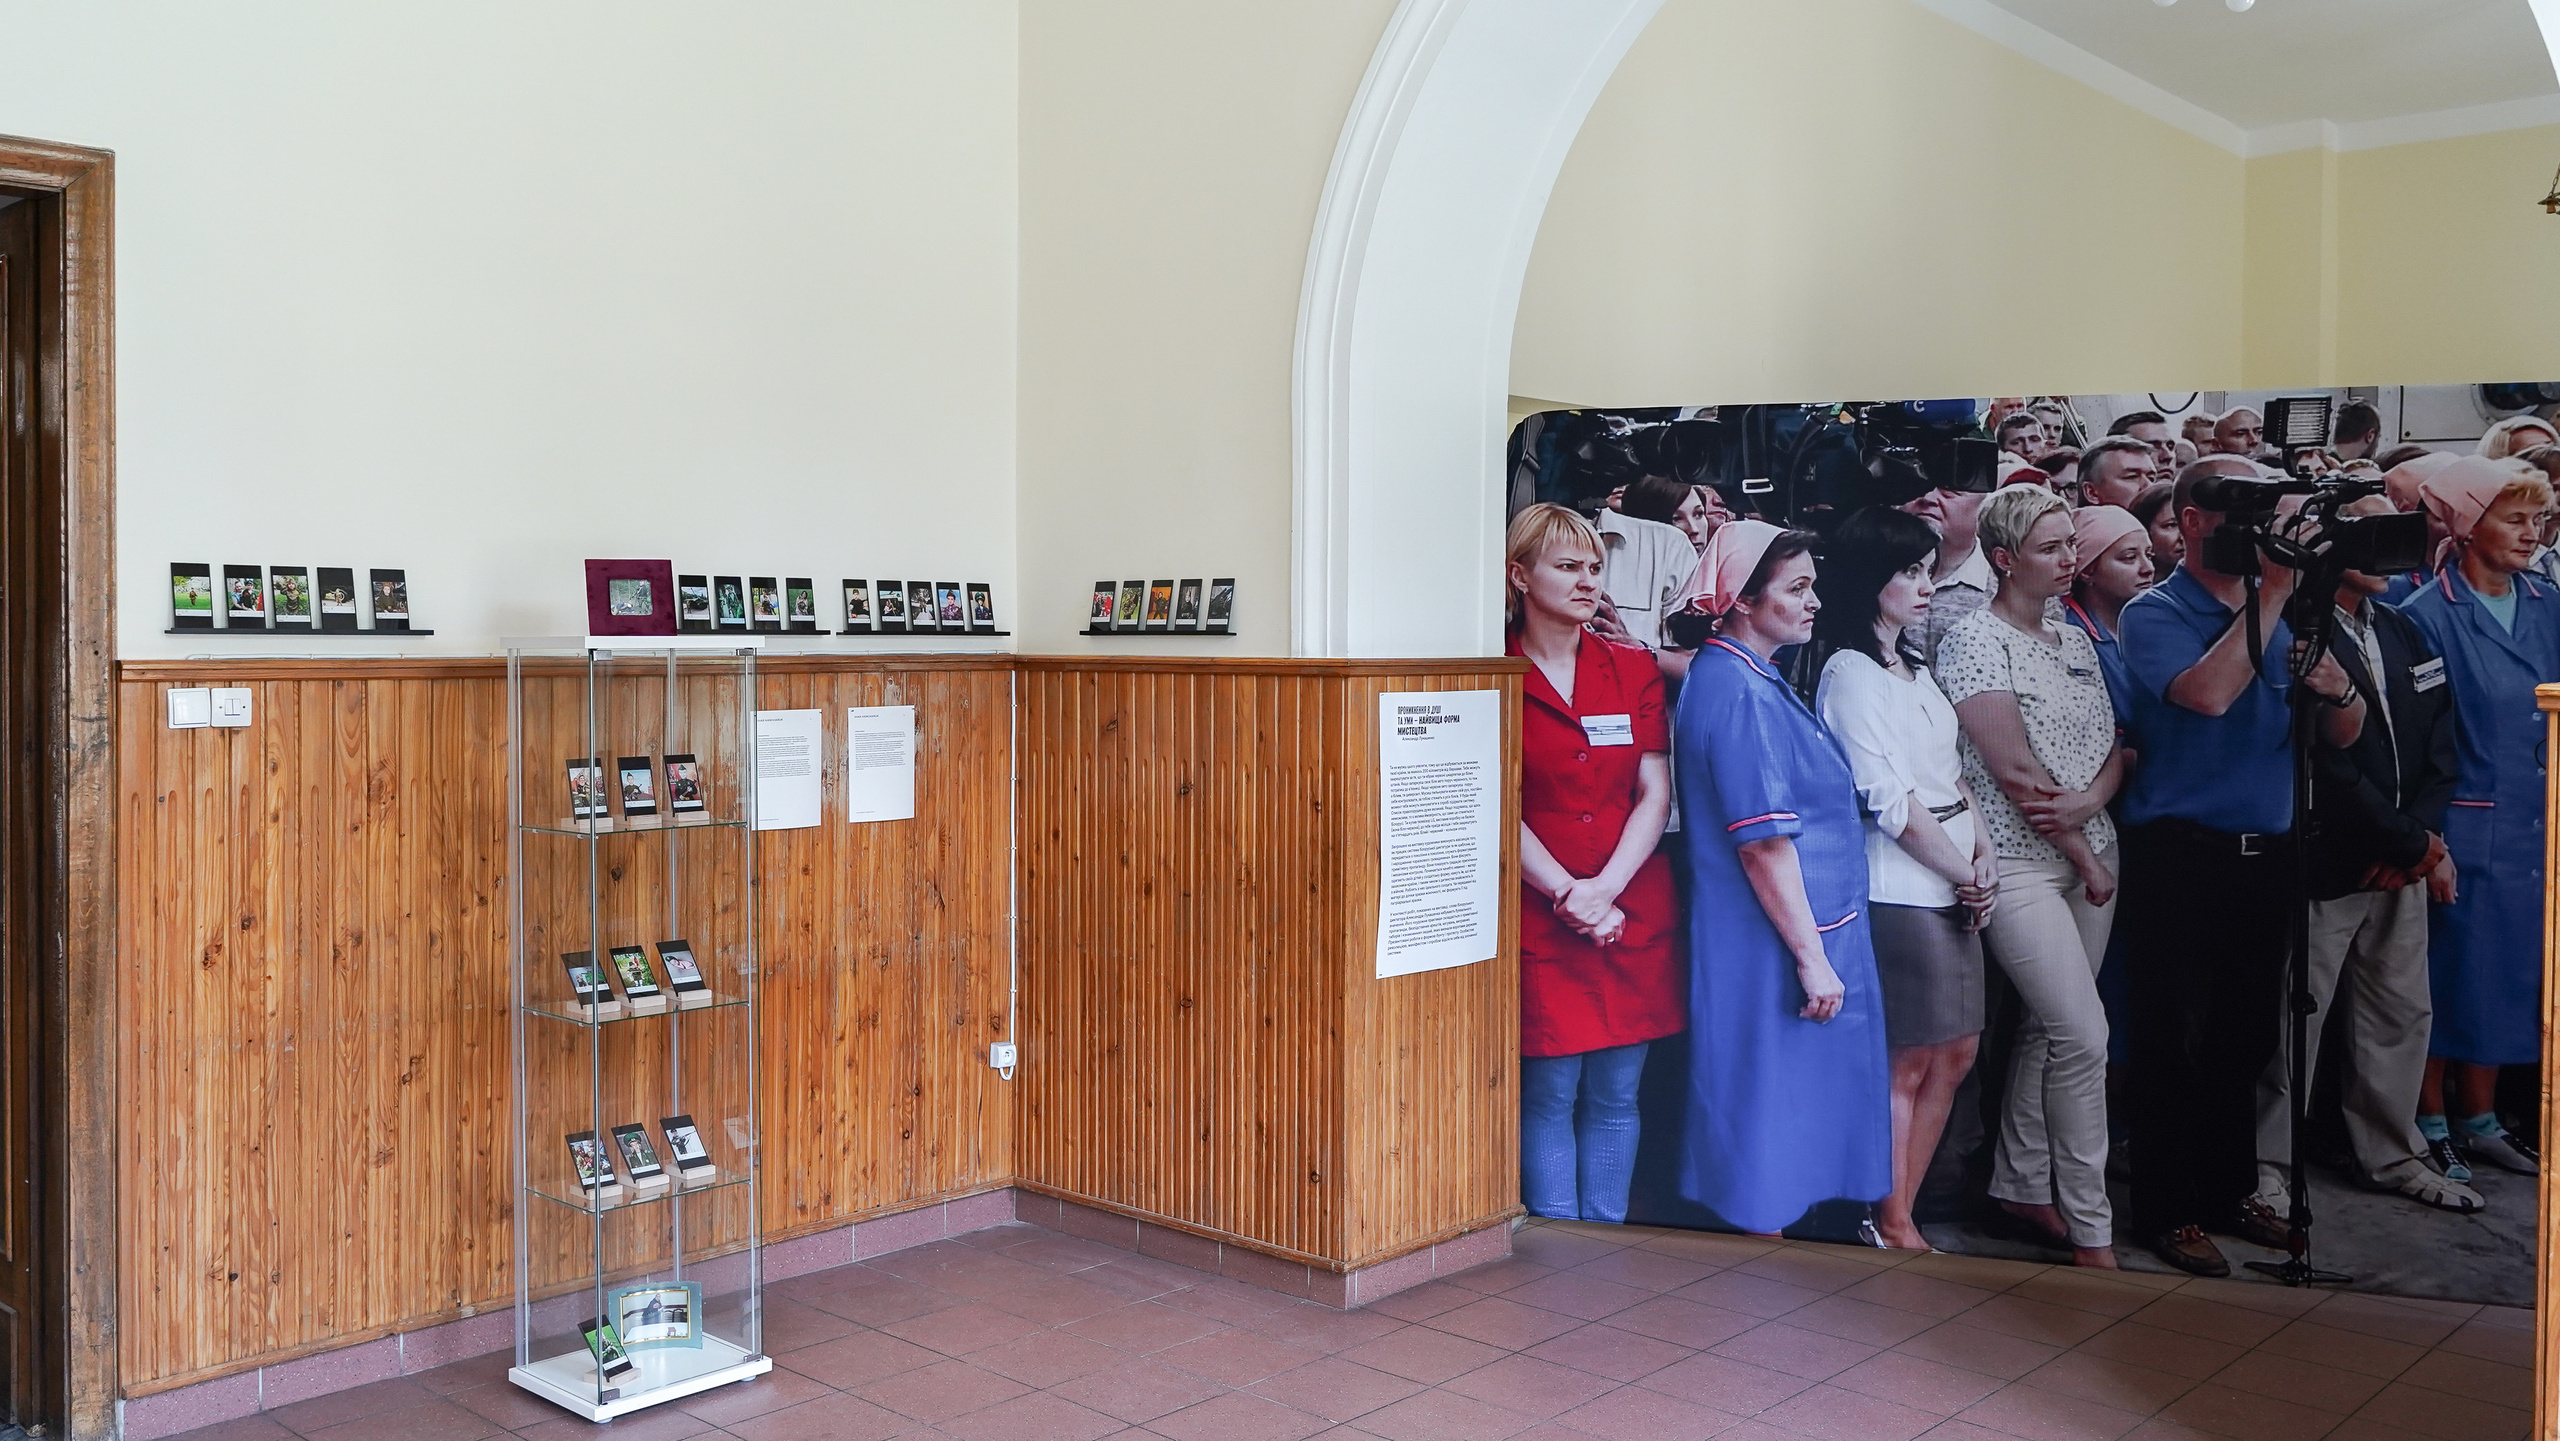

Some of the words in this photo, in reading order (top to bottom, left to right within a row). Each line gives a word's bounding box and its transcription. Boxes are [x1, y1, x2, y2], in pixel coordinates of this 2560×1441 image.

[1397, 705, 1427, 715] ПРОНИКНЕННЯ
[1397, 716, 1404, 725] ТА
[1404, 716, 1414, 725] УМИ
[1418, 714, 1443, 725] НАЙВИЩА
[1443, 714, 1460, 724] ФОРМА
[1397, 726, 1427, 736] МИСТЕЦТВА
